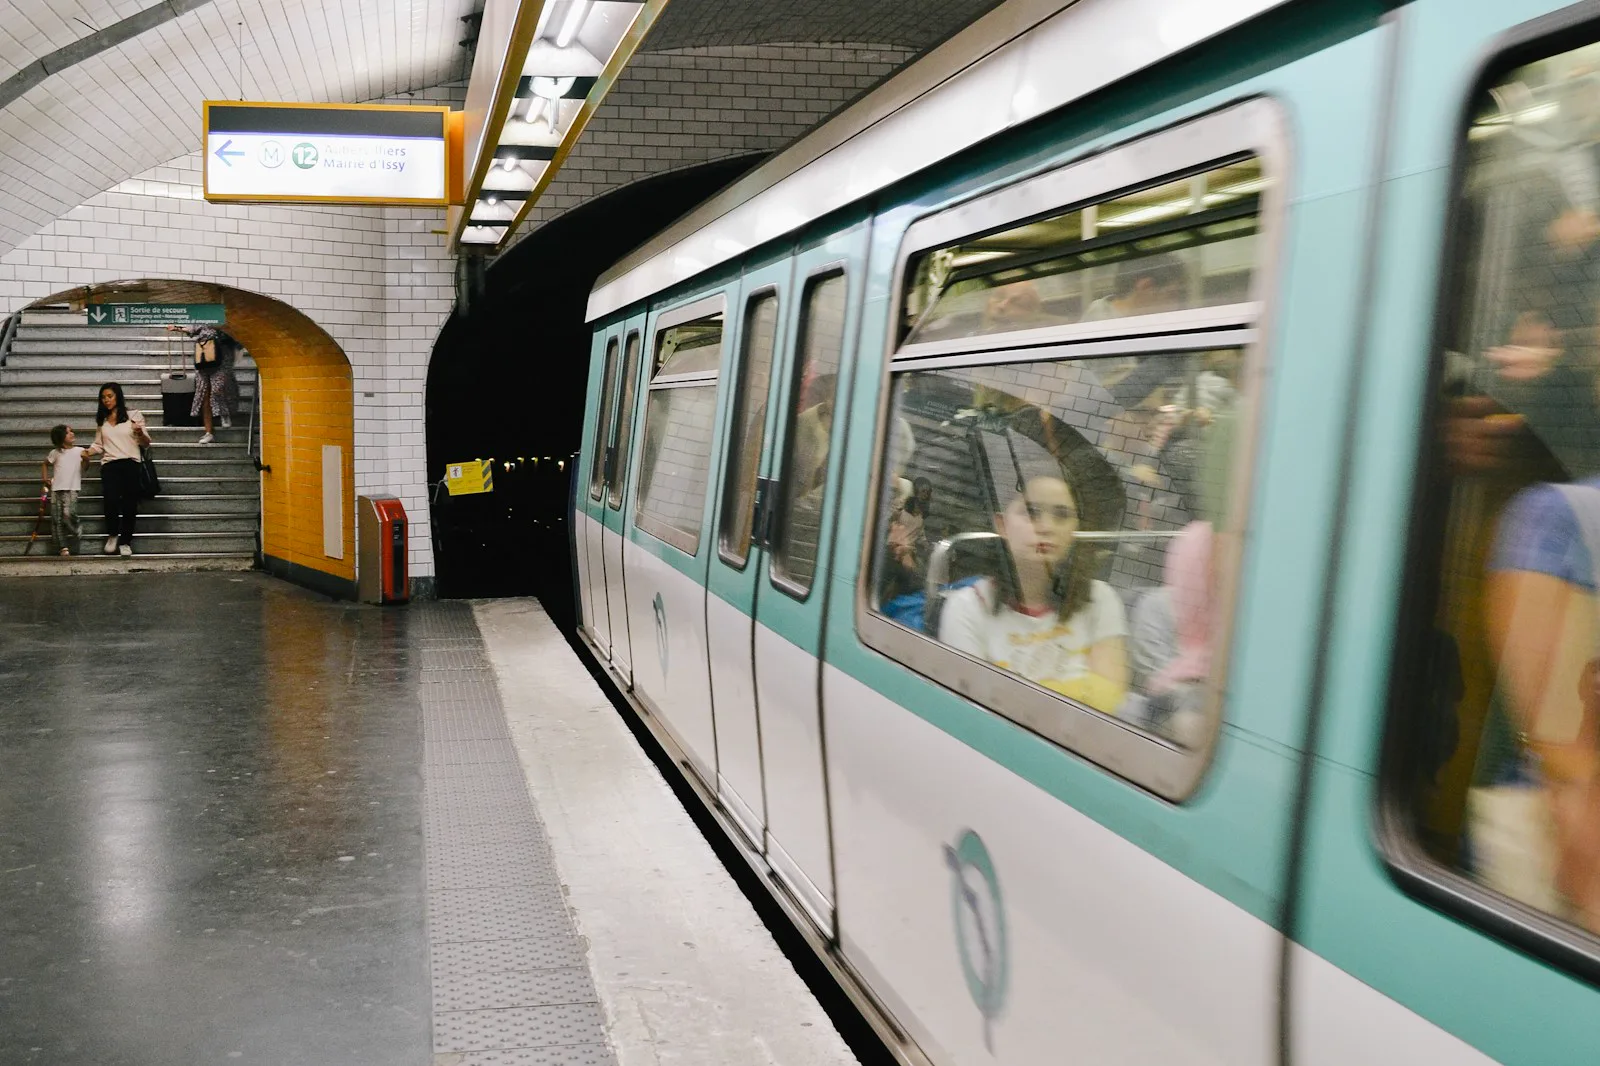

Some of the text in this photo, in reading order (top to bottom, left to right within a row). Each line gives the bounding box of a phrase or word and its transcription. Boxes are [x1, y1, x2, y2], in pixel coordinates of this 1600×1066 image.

[294, 146, 317, 165] 12
[325, 144, 406, 157] Auberlliers
[324, 158, 406, 173] Mairie d'Issy
